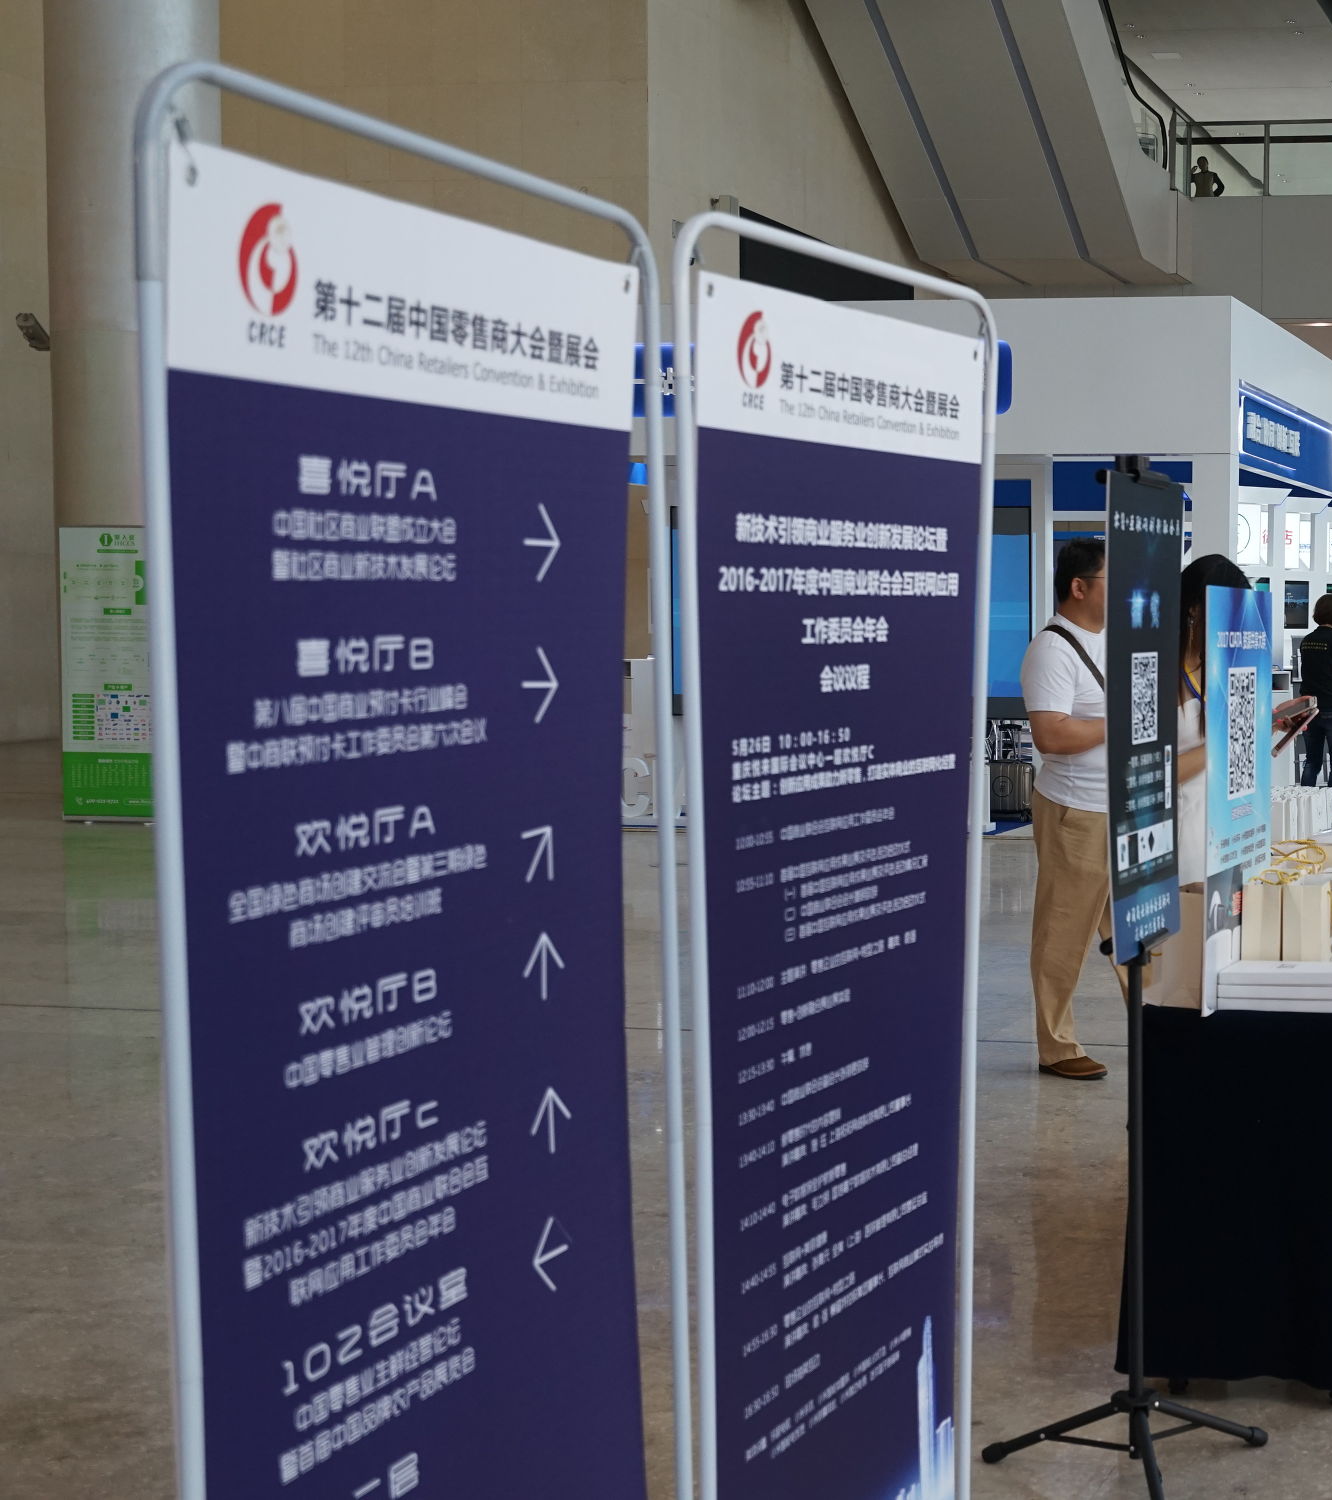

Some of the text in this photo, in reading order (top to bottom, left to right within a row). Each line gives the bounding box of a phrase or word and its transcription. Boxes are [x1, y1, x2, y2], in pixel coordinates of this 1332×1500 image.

[248, 320, 286, 348] CRCE
[313, 279, 599, 371] 第十二届中国零售商大会暨展会
[313, 334, 599, 399] The 12th China Retailers Convention & Exhibition
[780, 361, 960, 420] 第十二届中国零售商大会暨展会
[780, 399, 795, 415] The
[798, 402, 816, 418] 12th
[818, 406, 840, 423] China
[843, 410, 875, 429] Retailers
[877, 416, 917, 435] Convention
[927, 425, 960, 441] Exhibition
[297, 455, 437, 501] 喜悦厅A
[272, 509, 457, 545] 中国社区商业联盟成立大会
[735, 512, 948, 552] 新技术引领商业服务业创新发展论坛暨
[272, 550, 457, 581] 暨社区商业新技术发展论坛
[718, 566, 959, 597] 2016-2017年度中国商业联合会互联网应用
[801, 616, 889, 645] 工作委员会年会
[820, 664, 870, 692] 会议议程
[732, 735, 771, 756] 5月26日
[295, 805, 436, 856] 欢悦厅A
[299, 968, 437, 1036] 欢悦厅B
[303, 1100, 438, 1172] 欢悦厅C
[282, 1267, 468, 1396] 102会议室
